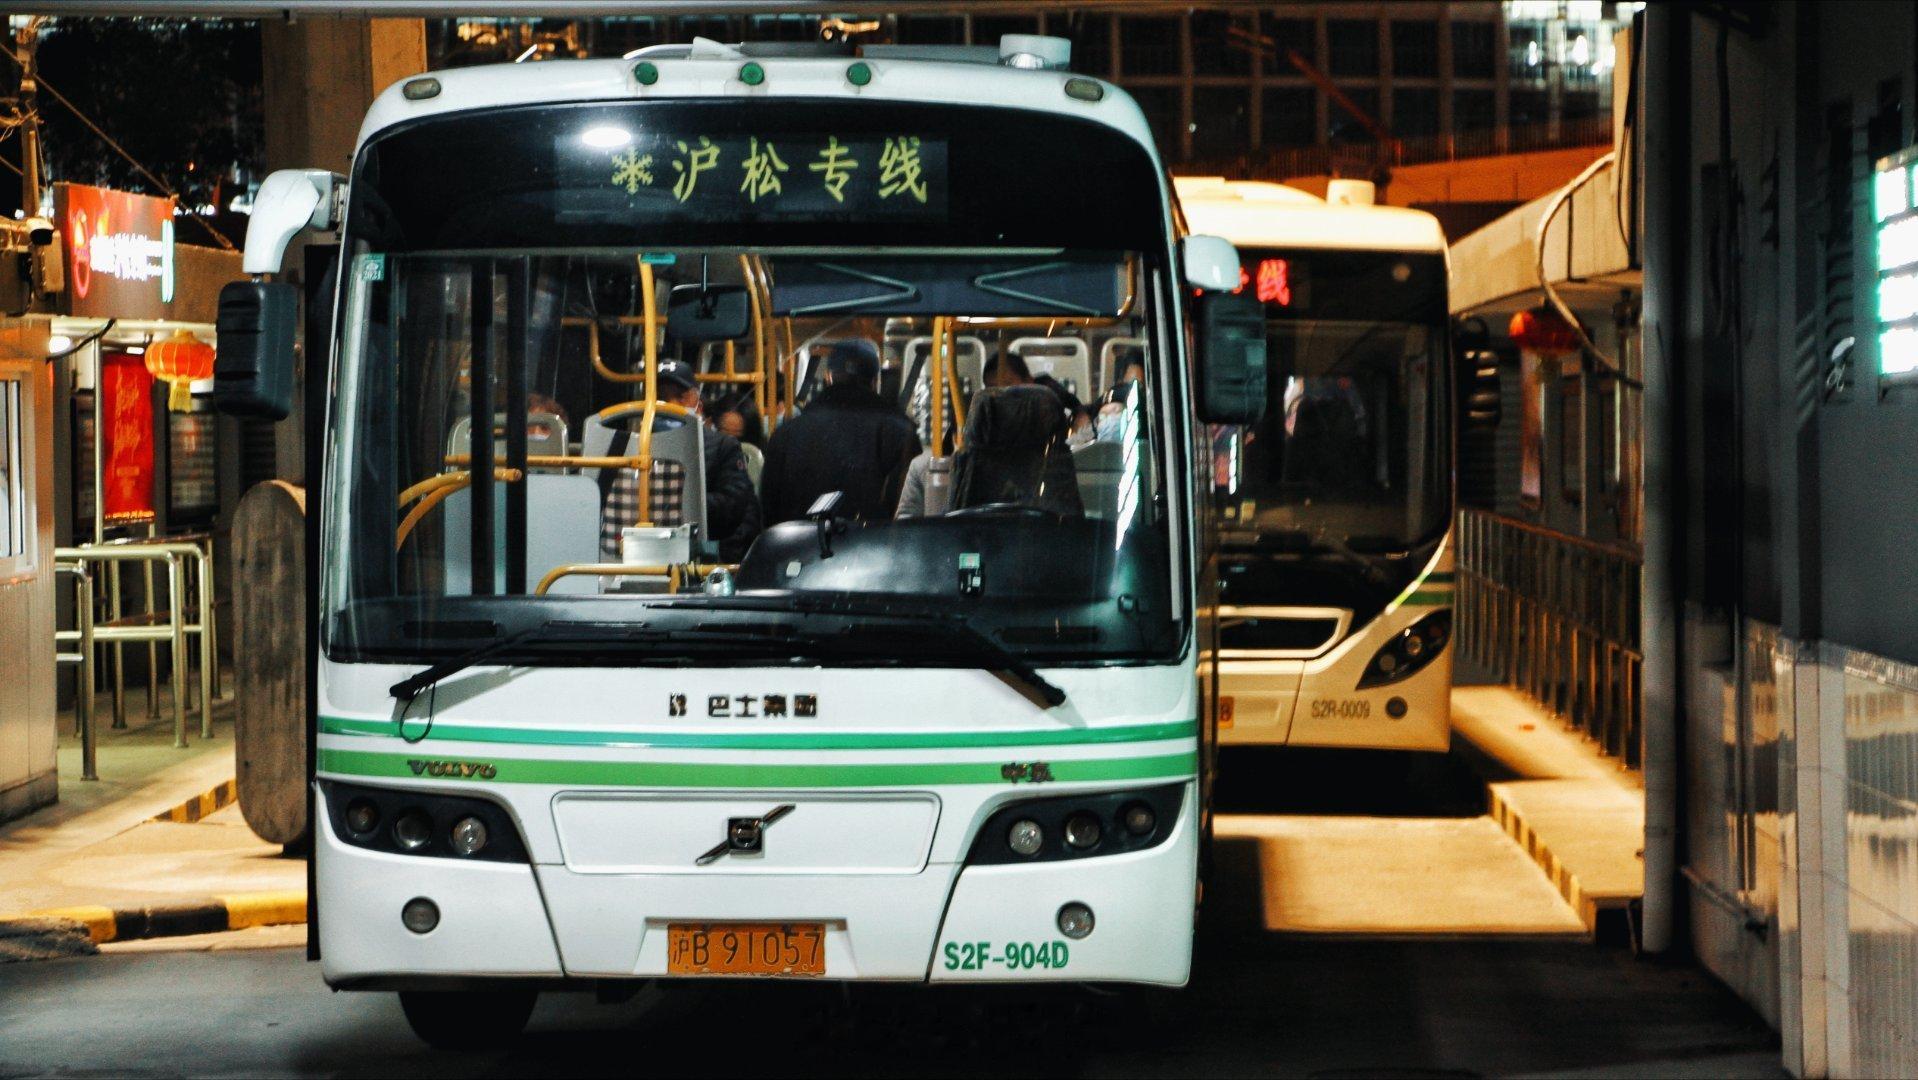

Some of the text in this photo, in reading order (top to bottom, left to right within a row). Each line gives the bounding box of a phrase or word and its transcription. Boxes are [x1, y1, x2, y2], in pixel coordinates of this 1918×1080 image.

[673, 135, 928, 203] 沪松专线
[407, 760, 498, 779] VOLVO
[944, 940, 1069, 970] S2F-904D
